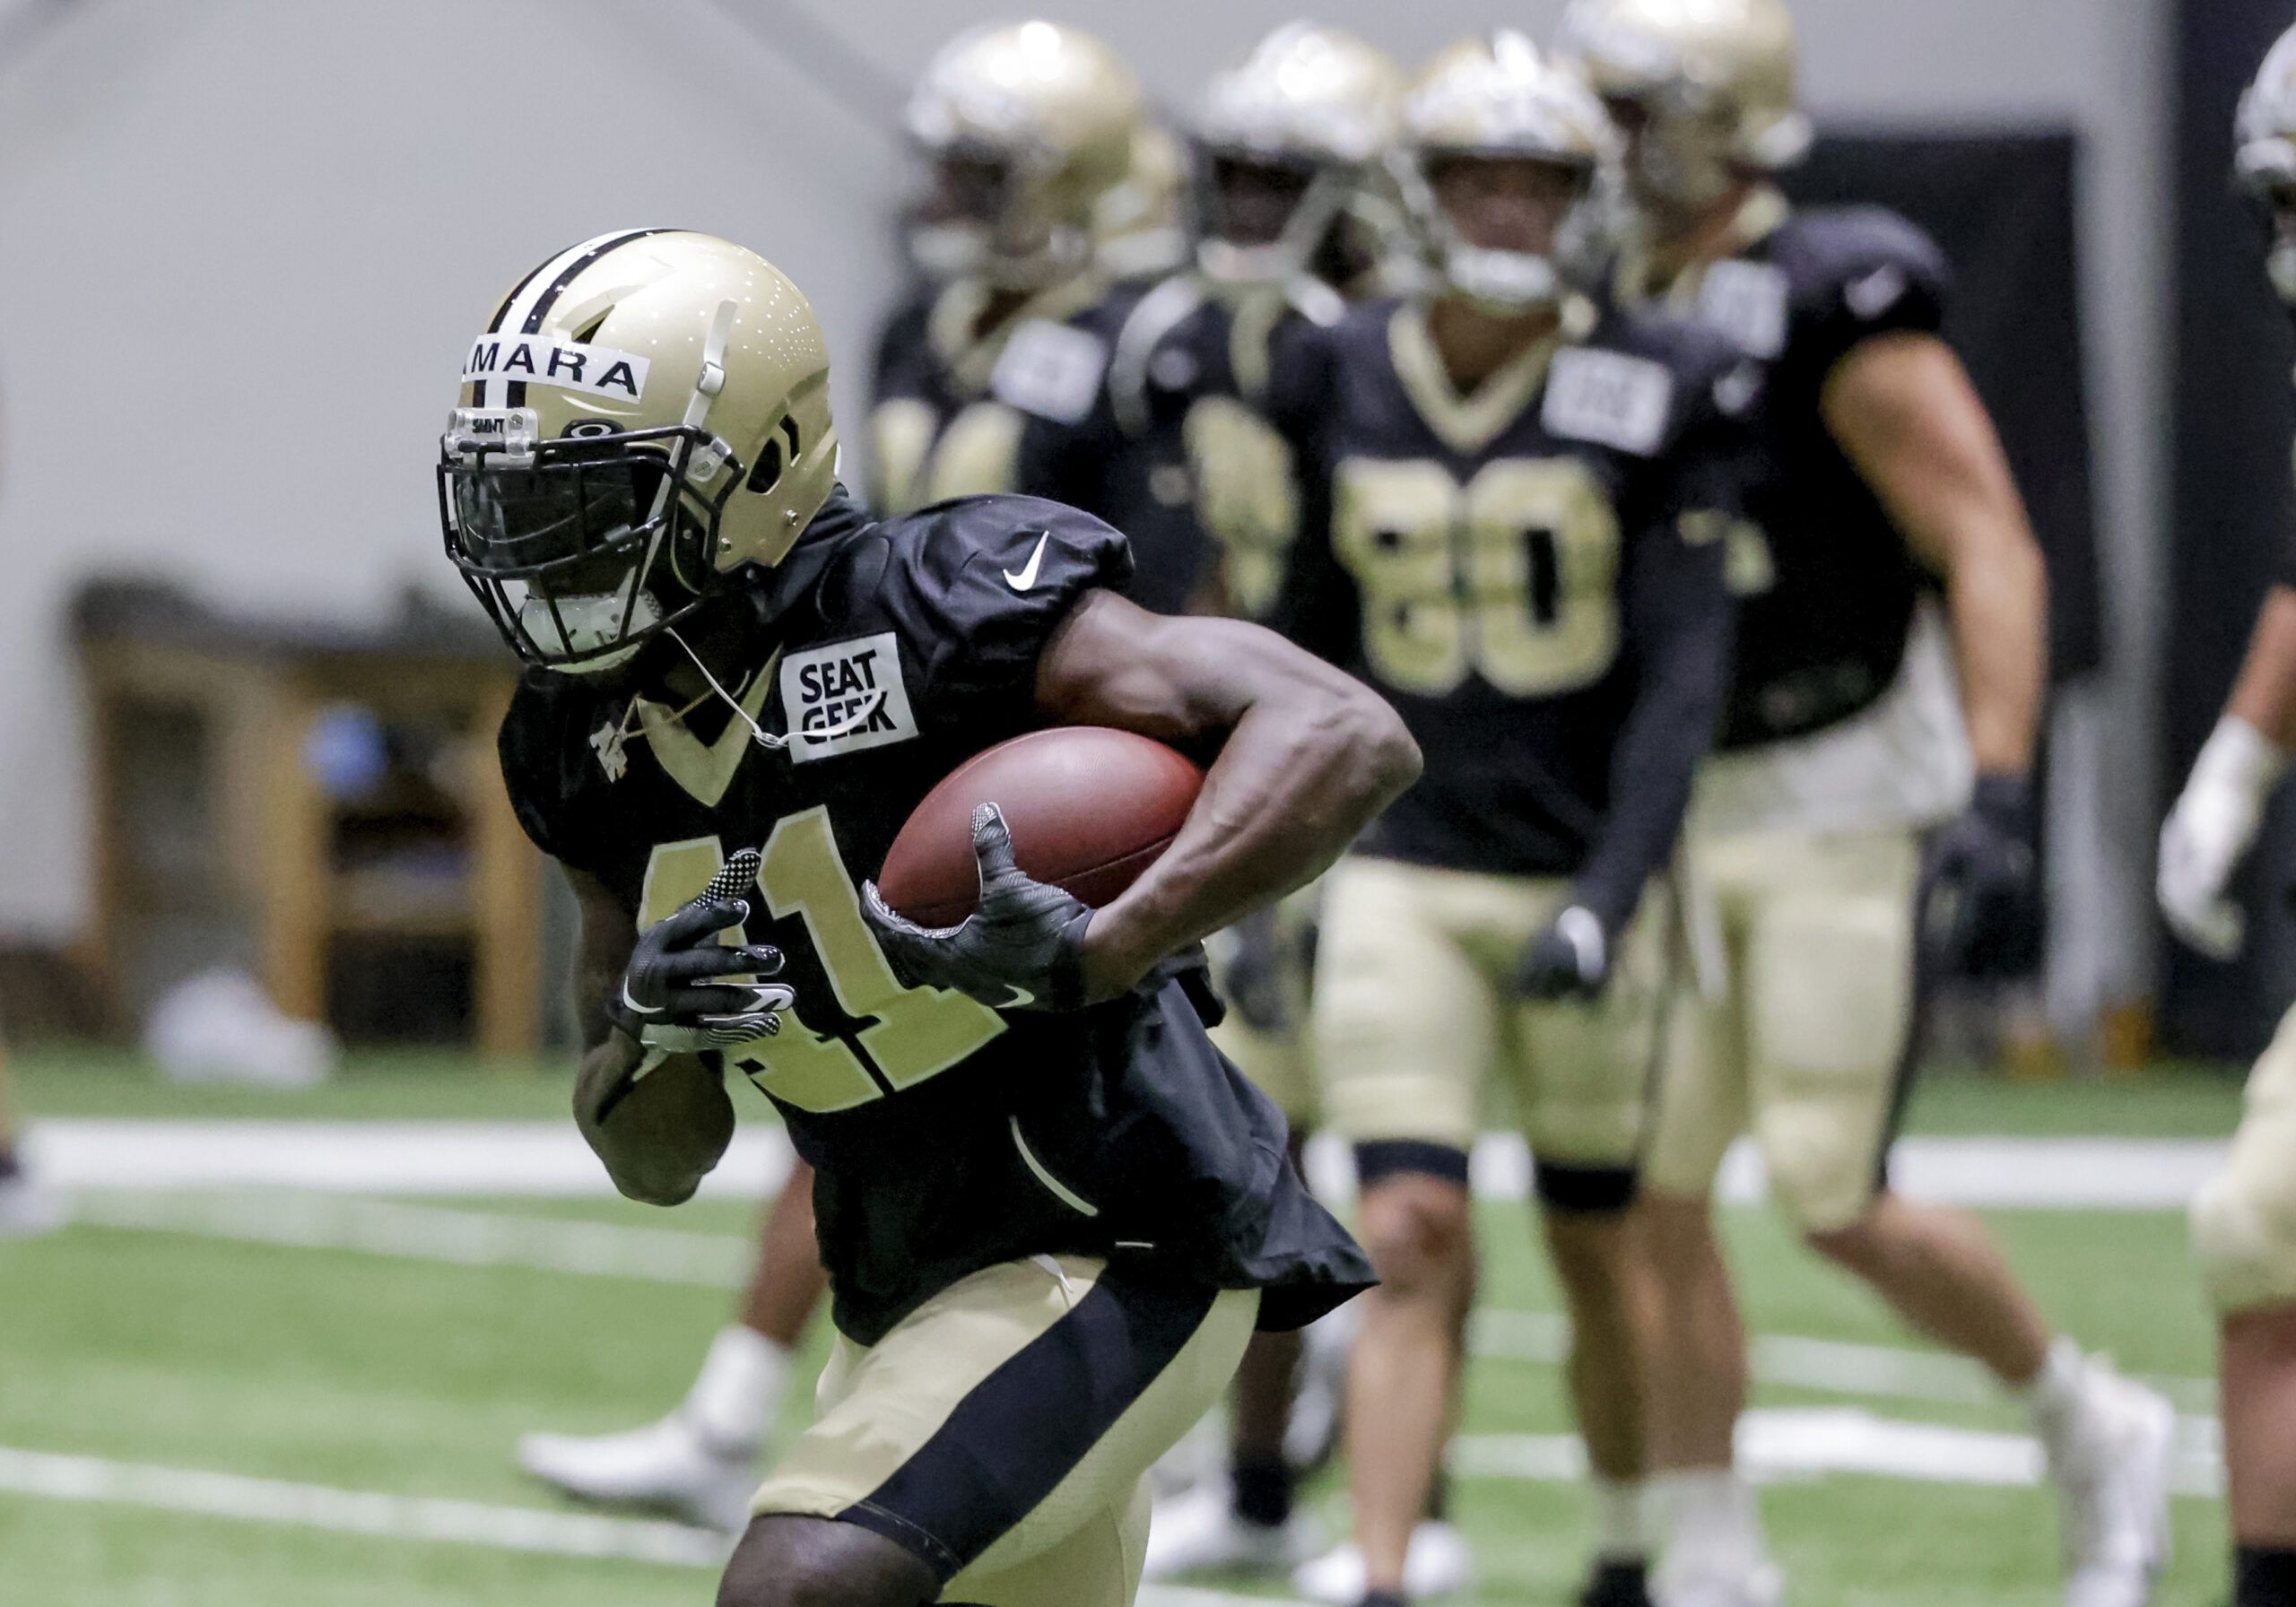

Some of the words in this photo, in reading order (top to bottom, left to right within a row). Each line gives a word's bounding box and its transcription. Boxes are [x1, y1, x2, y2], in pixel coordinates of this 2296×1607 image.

[462, 342, 639, 397] MARA
[799, 649, 877, 704] SEAT
[802, 691, 898, 744] GEEK
